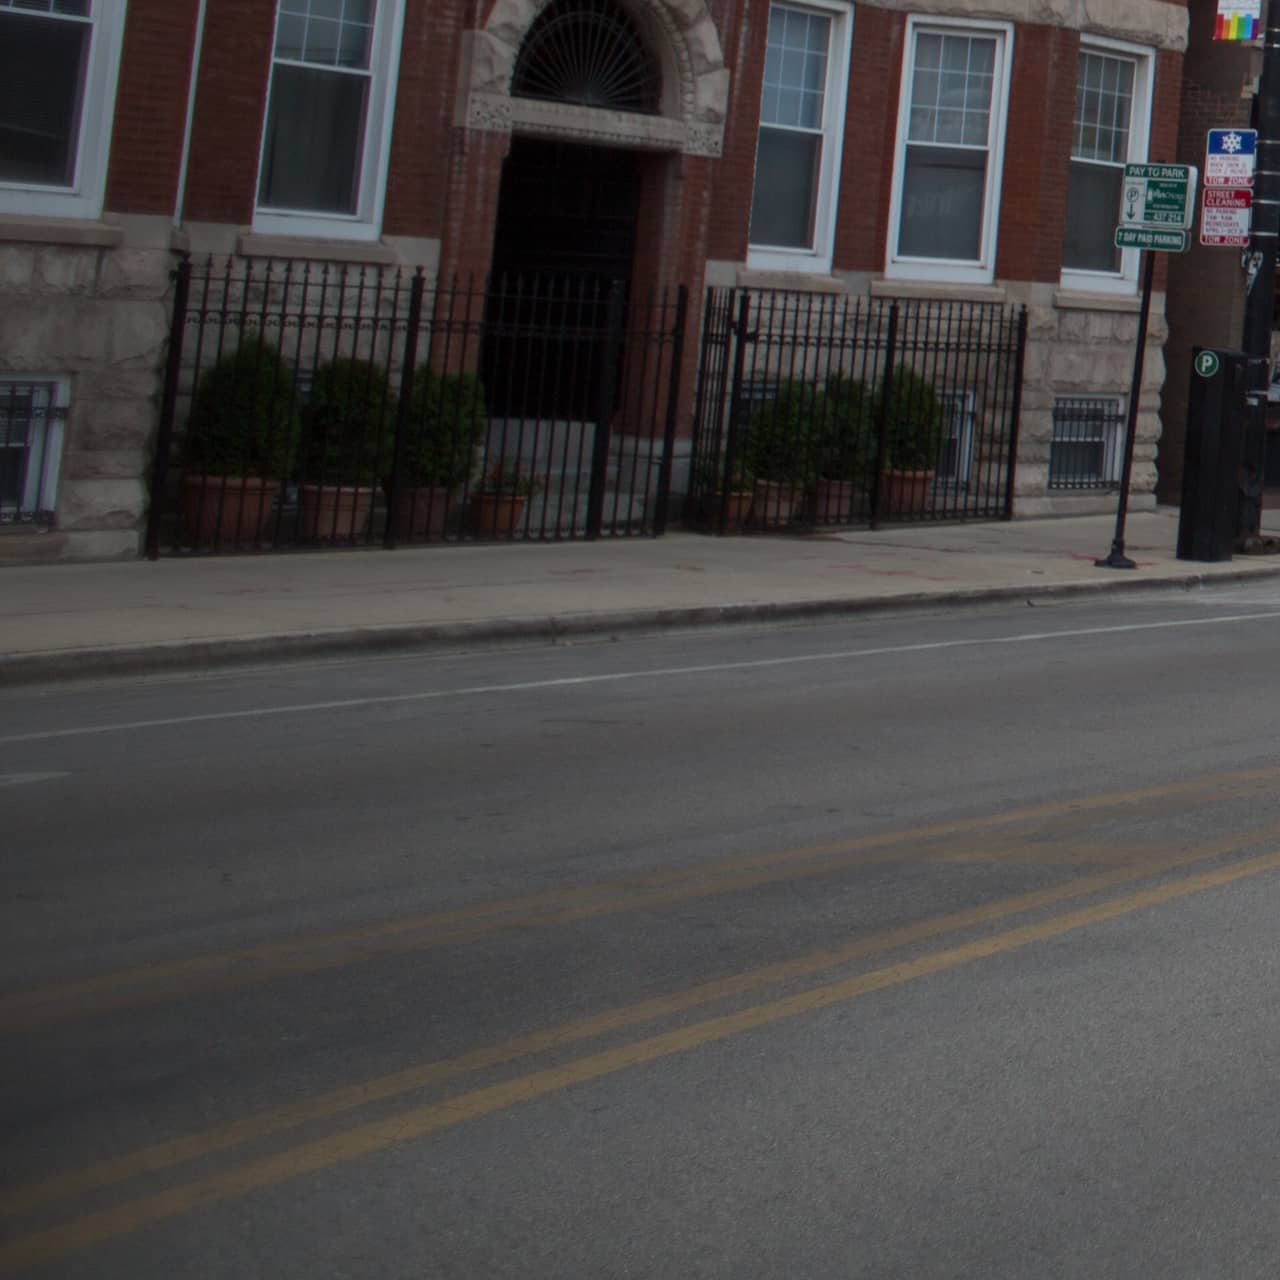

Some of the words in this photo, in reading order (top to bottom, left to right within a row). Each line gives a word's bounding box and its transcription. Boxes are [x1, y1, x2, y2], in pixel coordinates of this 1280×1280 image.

[1129, 166, 1146, 175] PAY
[1148, 167, 1159, 177] TO
[1161, 167, 1185, 177] PARK
[1208, 176, 1223, 184] TOW
[1230, 176, 1248, 184] ZONE
[1207, 190, 1236, 198] STREET
[1206, 198, 1247, 207] CLEANING
[1154, 234, 1182, 245] PARKING
[1205, 236, 1221, 244] TOW
[1226, 236, 1243, 244] ZONE
[1201, 355, 1213, 373] P
